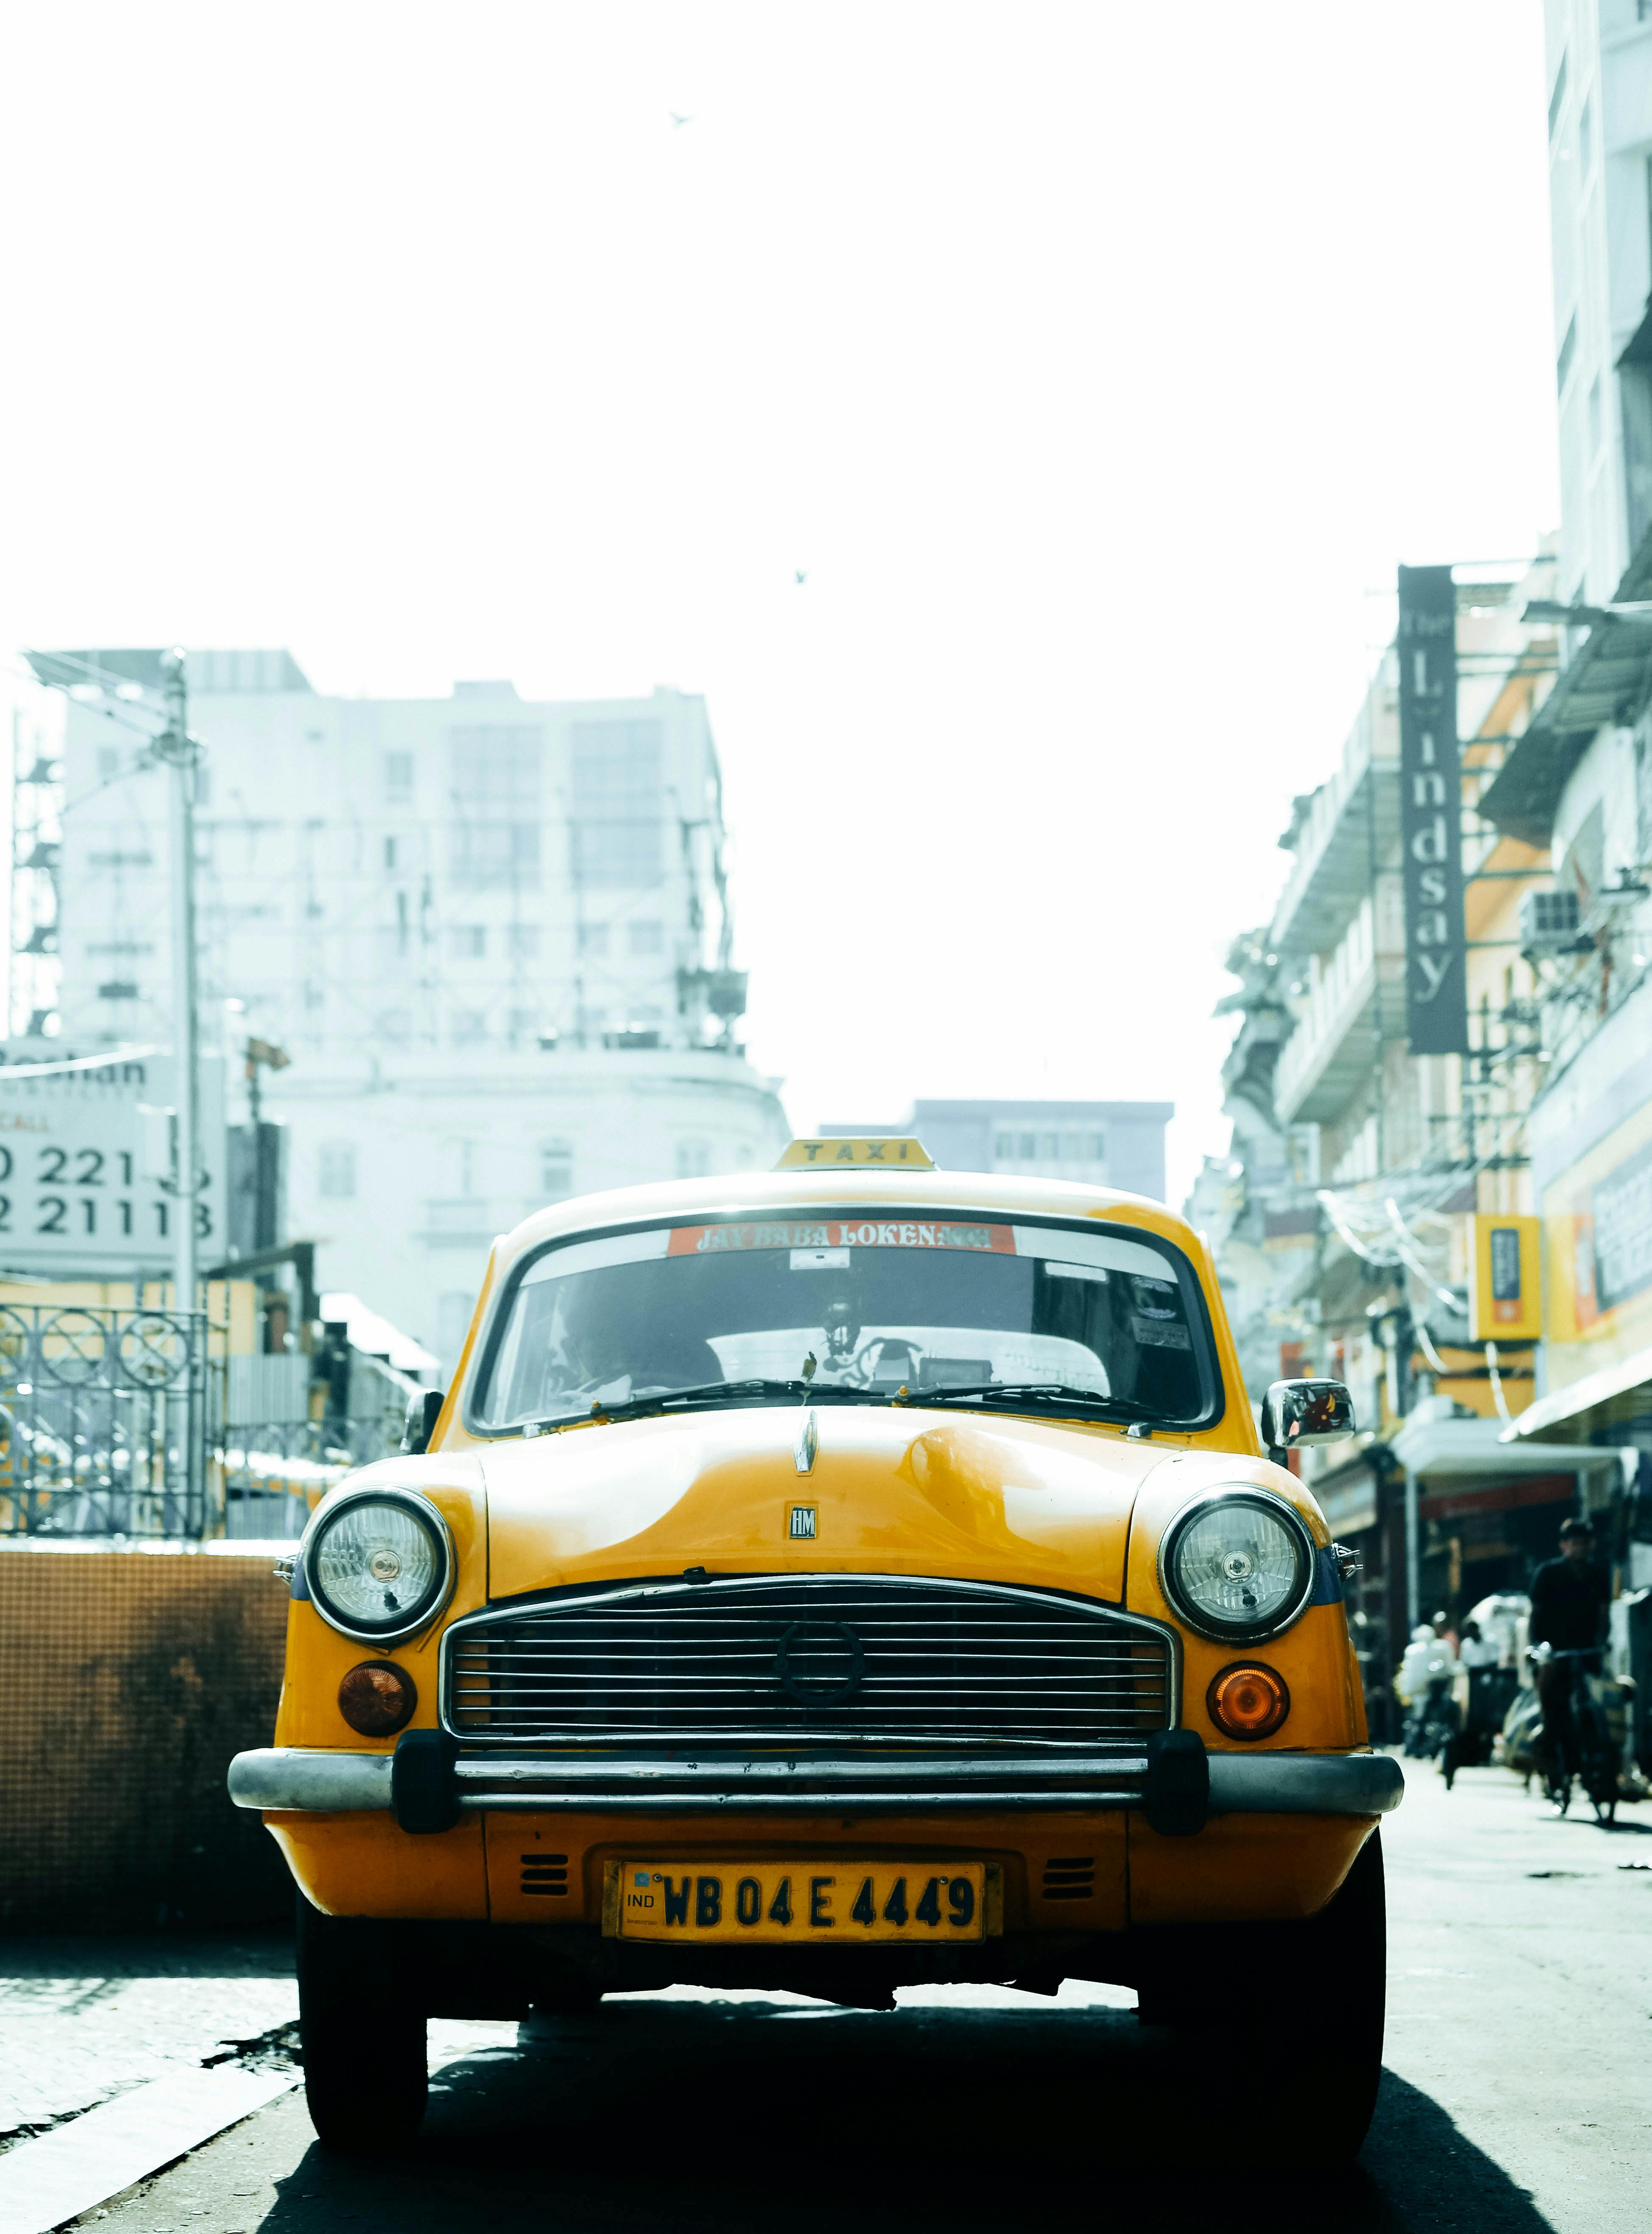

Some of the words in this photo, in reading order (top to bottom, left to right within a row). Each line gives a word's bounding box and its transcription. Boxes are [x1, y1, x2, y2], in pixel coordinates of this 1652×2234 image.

[803, 1143, 908, 1161] TAXI
[696, 1227, 747, 1251] JAY
[753, 1225, 830, 1247] BABA
[792, 1510, 815, 1535] HM
[627, 1894, 655, 1909] IND
[852, 1877, 974, 1928] 4449
